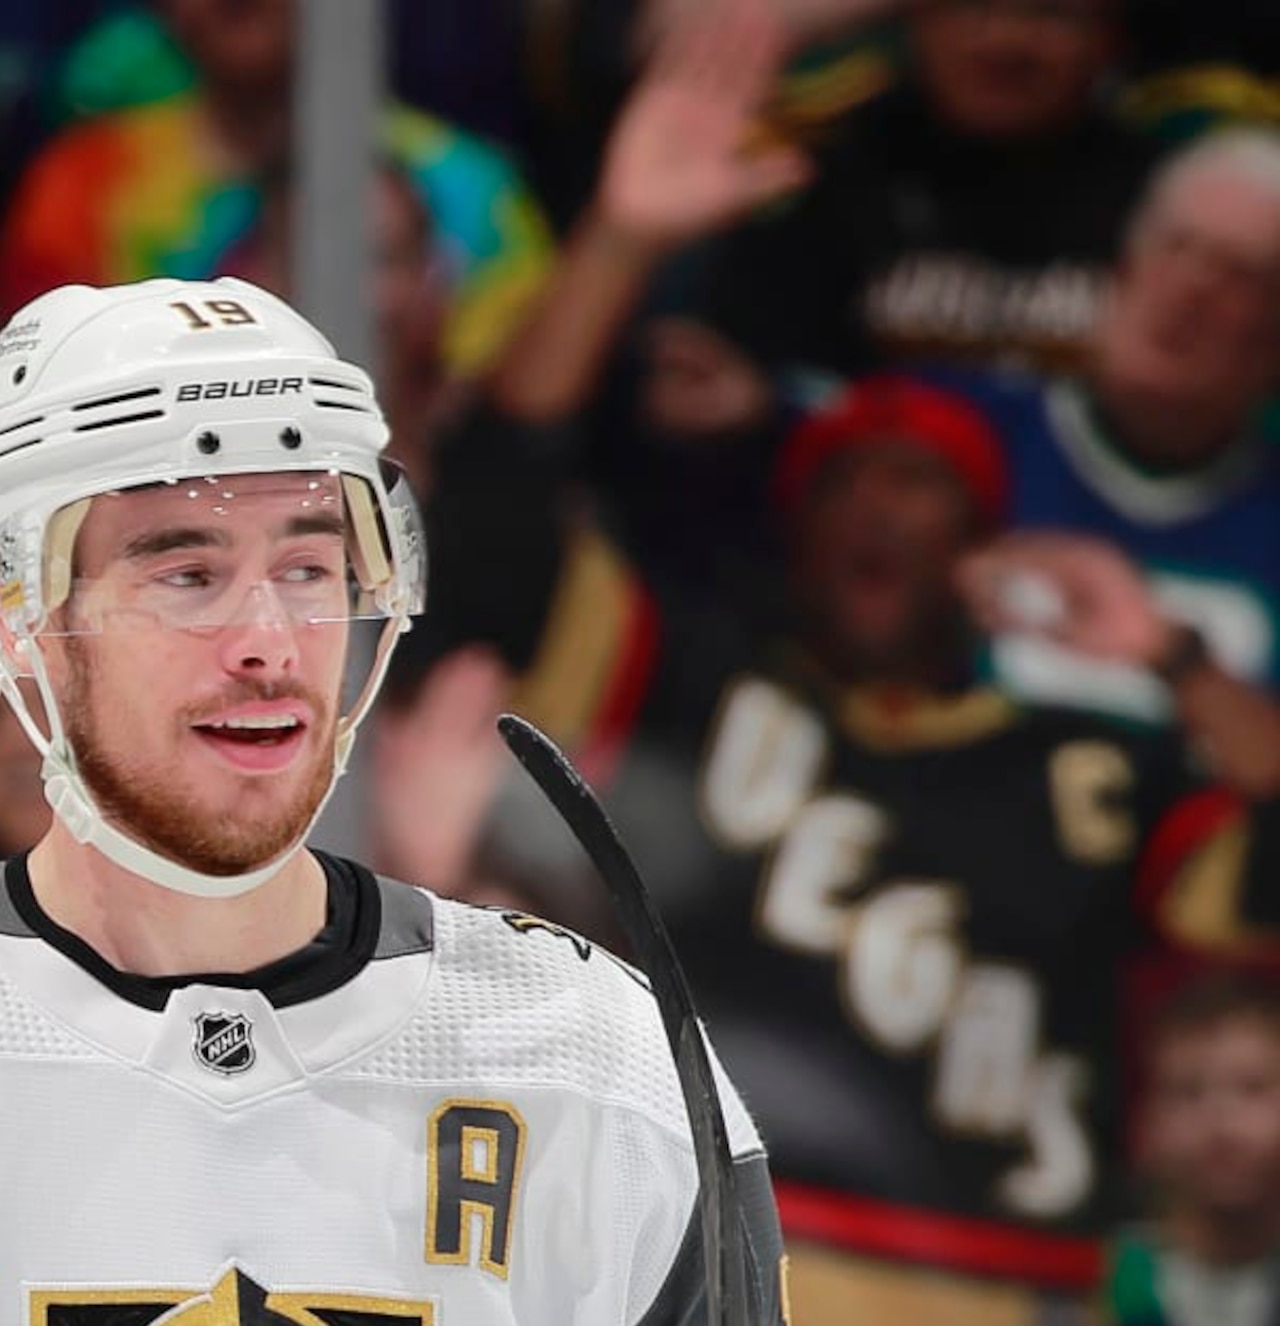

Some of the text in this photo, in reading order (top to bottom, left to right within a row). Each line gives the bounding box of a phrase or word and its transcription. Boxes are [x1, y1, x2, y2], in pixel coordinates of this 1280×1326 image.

[170, 299, 258, 330] 19
[207, 1026, 245, 1061] NHL
[425, 1096, 529, 1281] A
